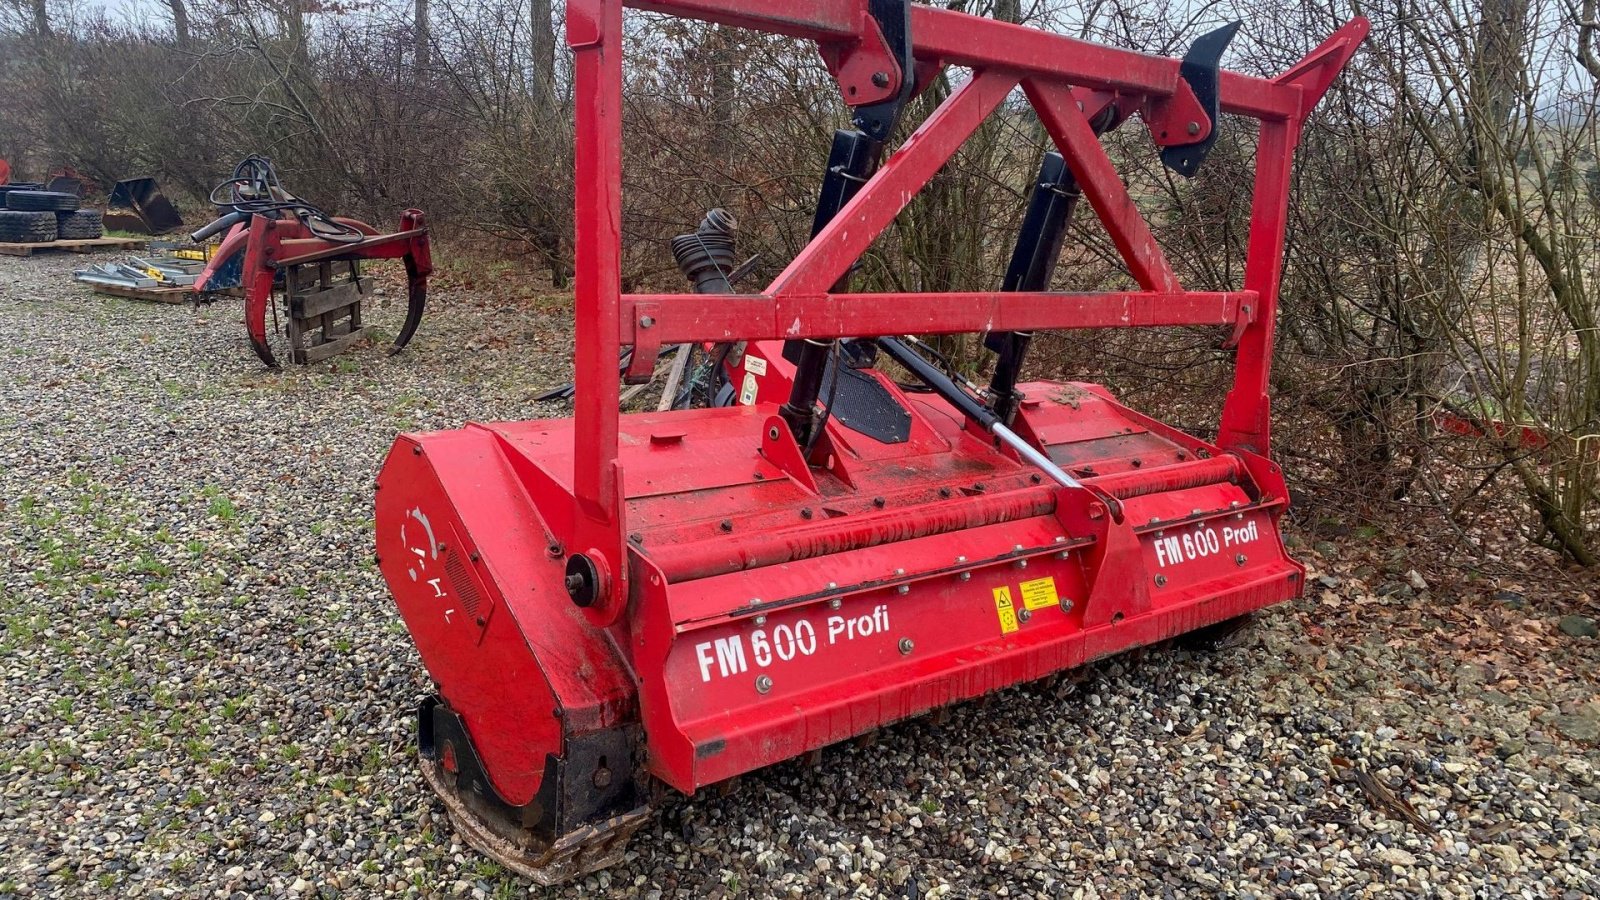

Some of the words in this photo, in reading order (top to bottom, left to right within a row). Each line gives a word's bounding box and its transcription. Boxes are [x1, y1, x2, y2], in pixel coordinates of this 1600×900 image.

[1154, 536, 1184, 567] FM
[1183, 528, 1219, 560] 600
[1223, 520, 1258, 547] Profi
[695, 635, 748, 682] FM
[751, 619, 817, 667] 600
[827, 604, 889, 644] Profi
